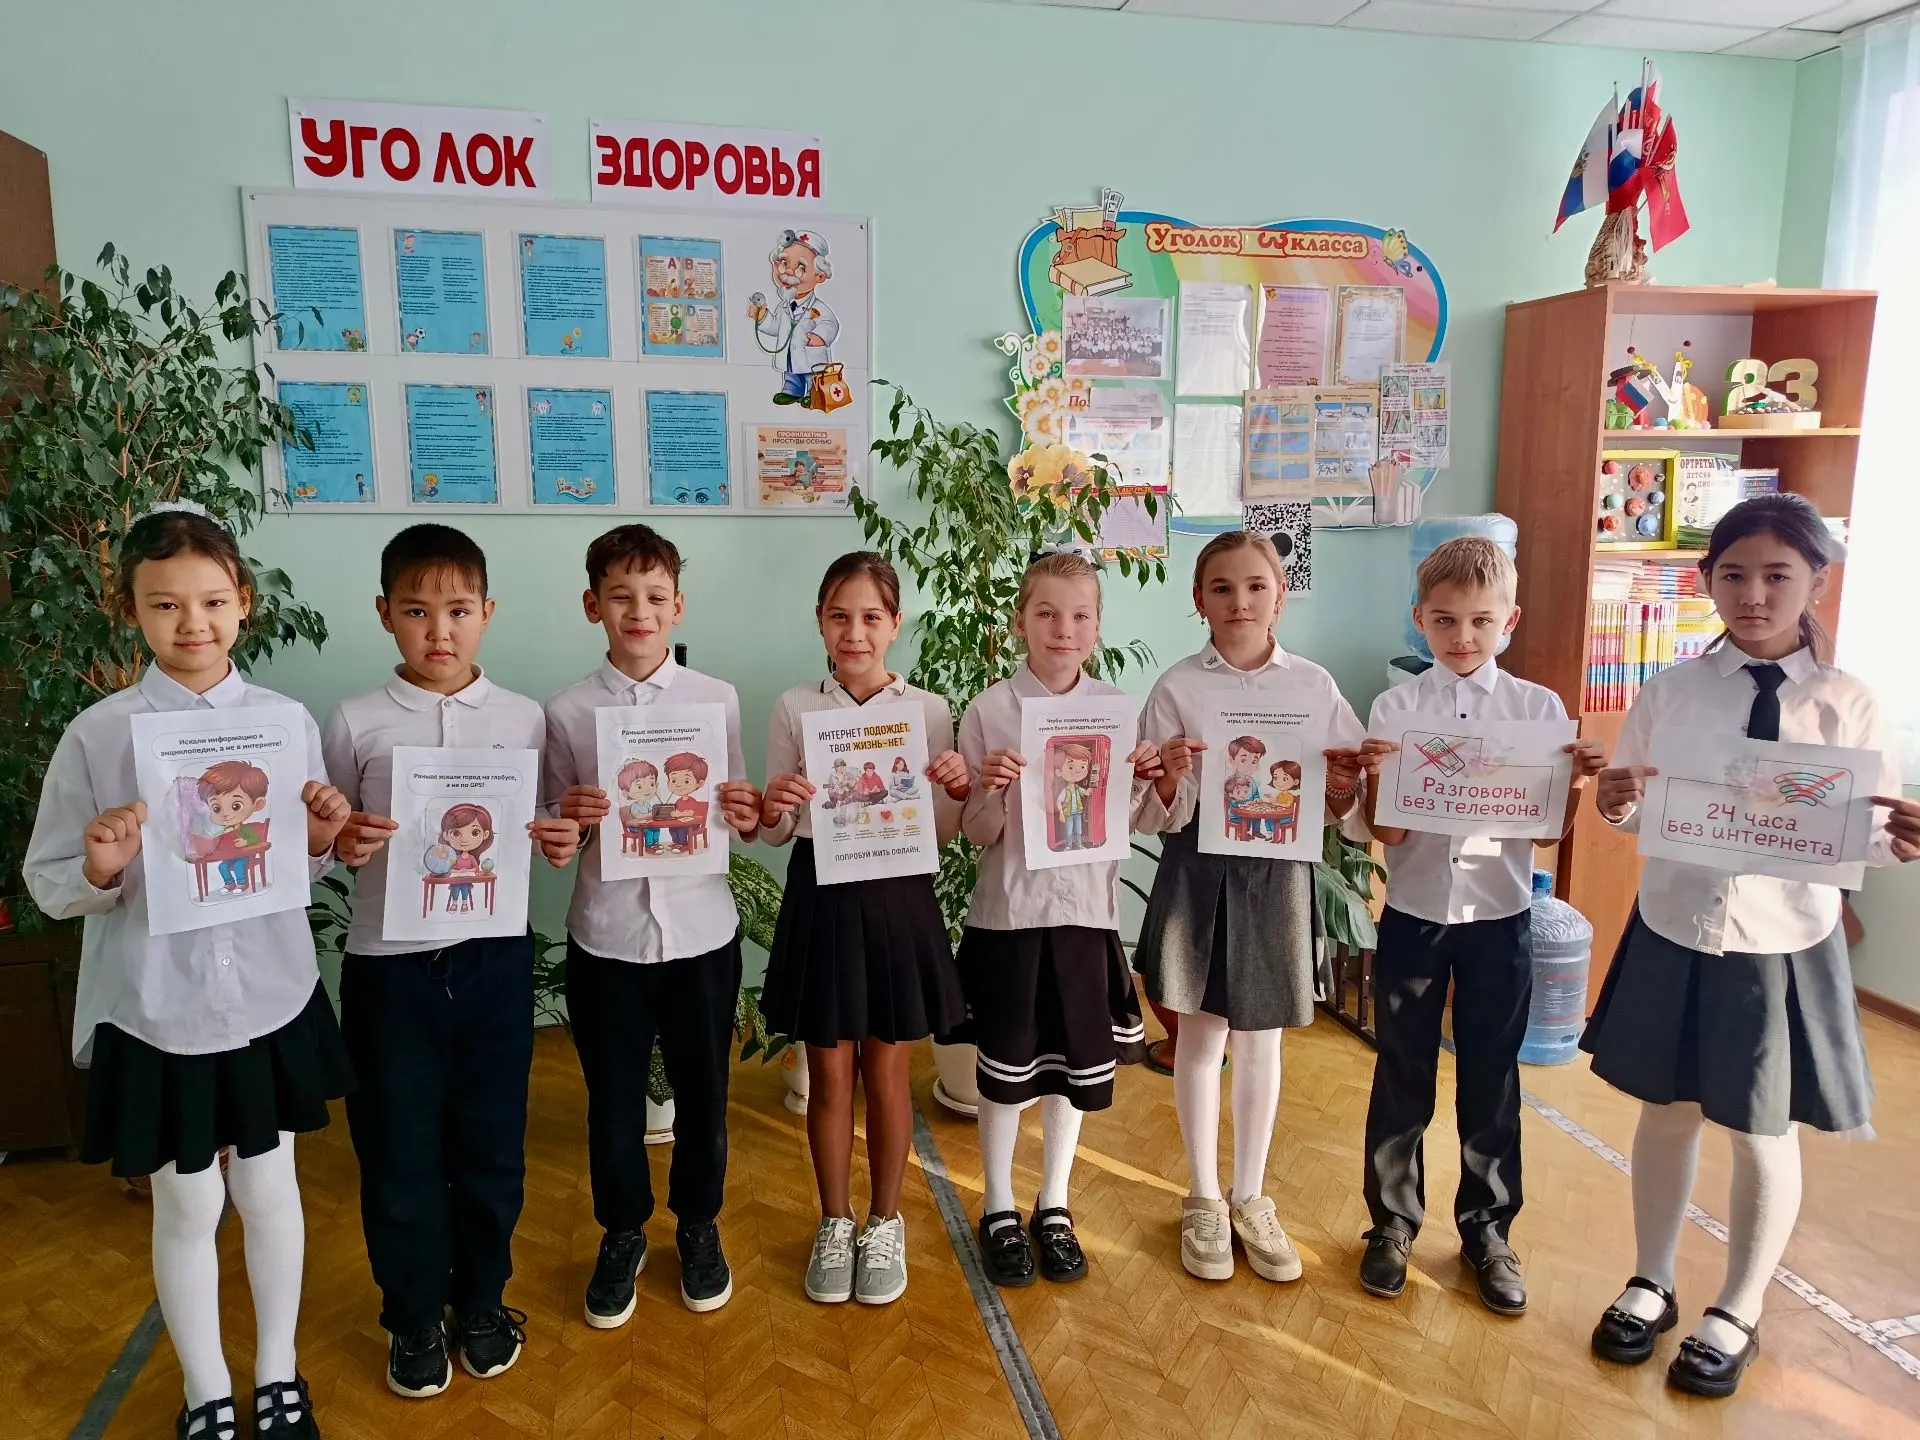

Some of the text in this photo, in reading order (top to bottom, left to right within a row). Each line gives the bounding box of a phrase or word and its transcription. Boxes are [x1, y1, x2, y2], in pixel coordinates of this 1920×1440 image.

[596, 135, 820, 198] ЗДОРОВЬЯ
[1152, 228, 1238, 248] Уголок
[1290, 236, 1364, 253] класса
[1680, 458, 1715, 469] ОРТРЕТЫ
[207, 734, 258, 745] информацию
[638, 735, 695, 744] радиоприёмнику!
[673, 727, 701, 735] слушали
[818, 722, 911, 741] ИНТЕРНЕТ ПОДОЖДЁТ.
[160, 746, 218, 757] энциклопедии,
[242, 740, 282, 750] интернете!
[829, 743, 851, 753] ТВОЯ
[1423, 777, 1527, 799] Разговоры
[1444, 800, 1541, 817] телефона
[1706, 803, 1799, 832] 24 часа
[1712, 826, 1835, 857] интернета
[835, 846, 921, 862] ПОПРОБУЙ ЖИТЬ ОФЛАЙН.
